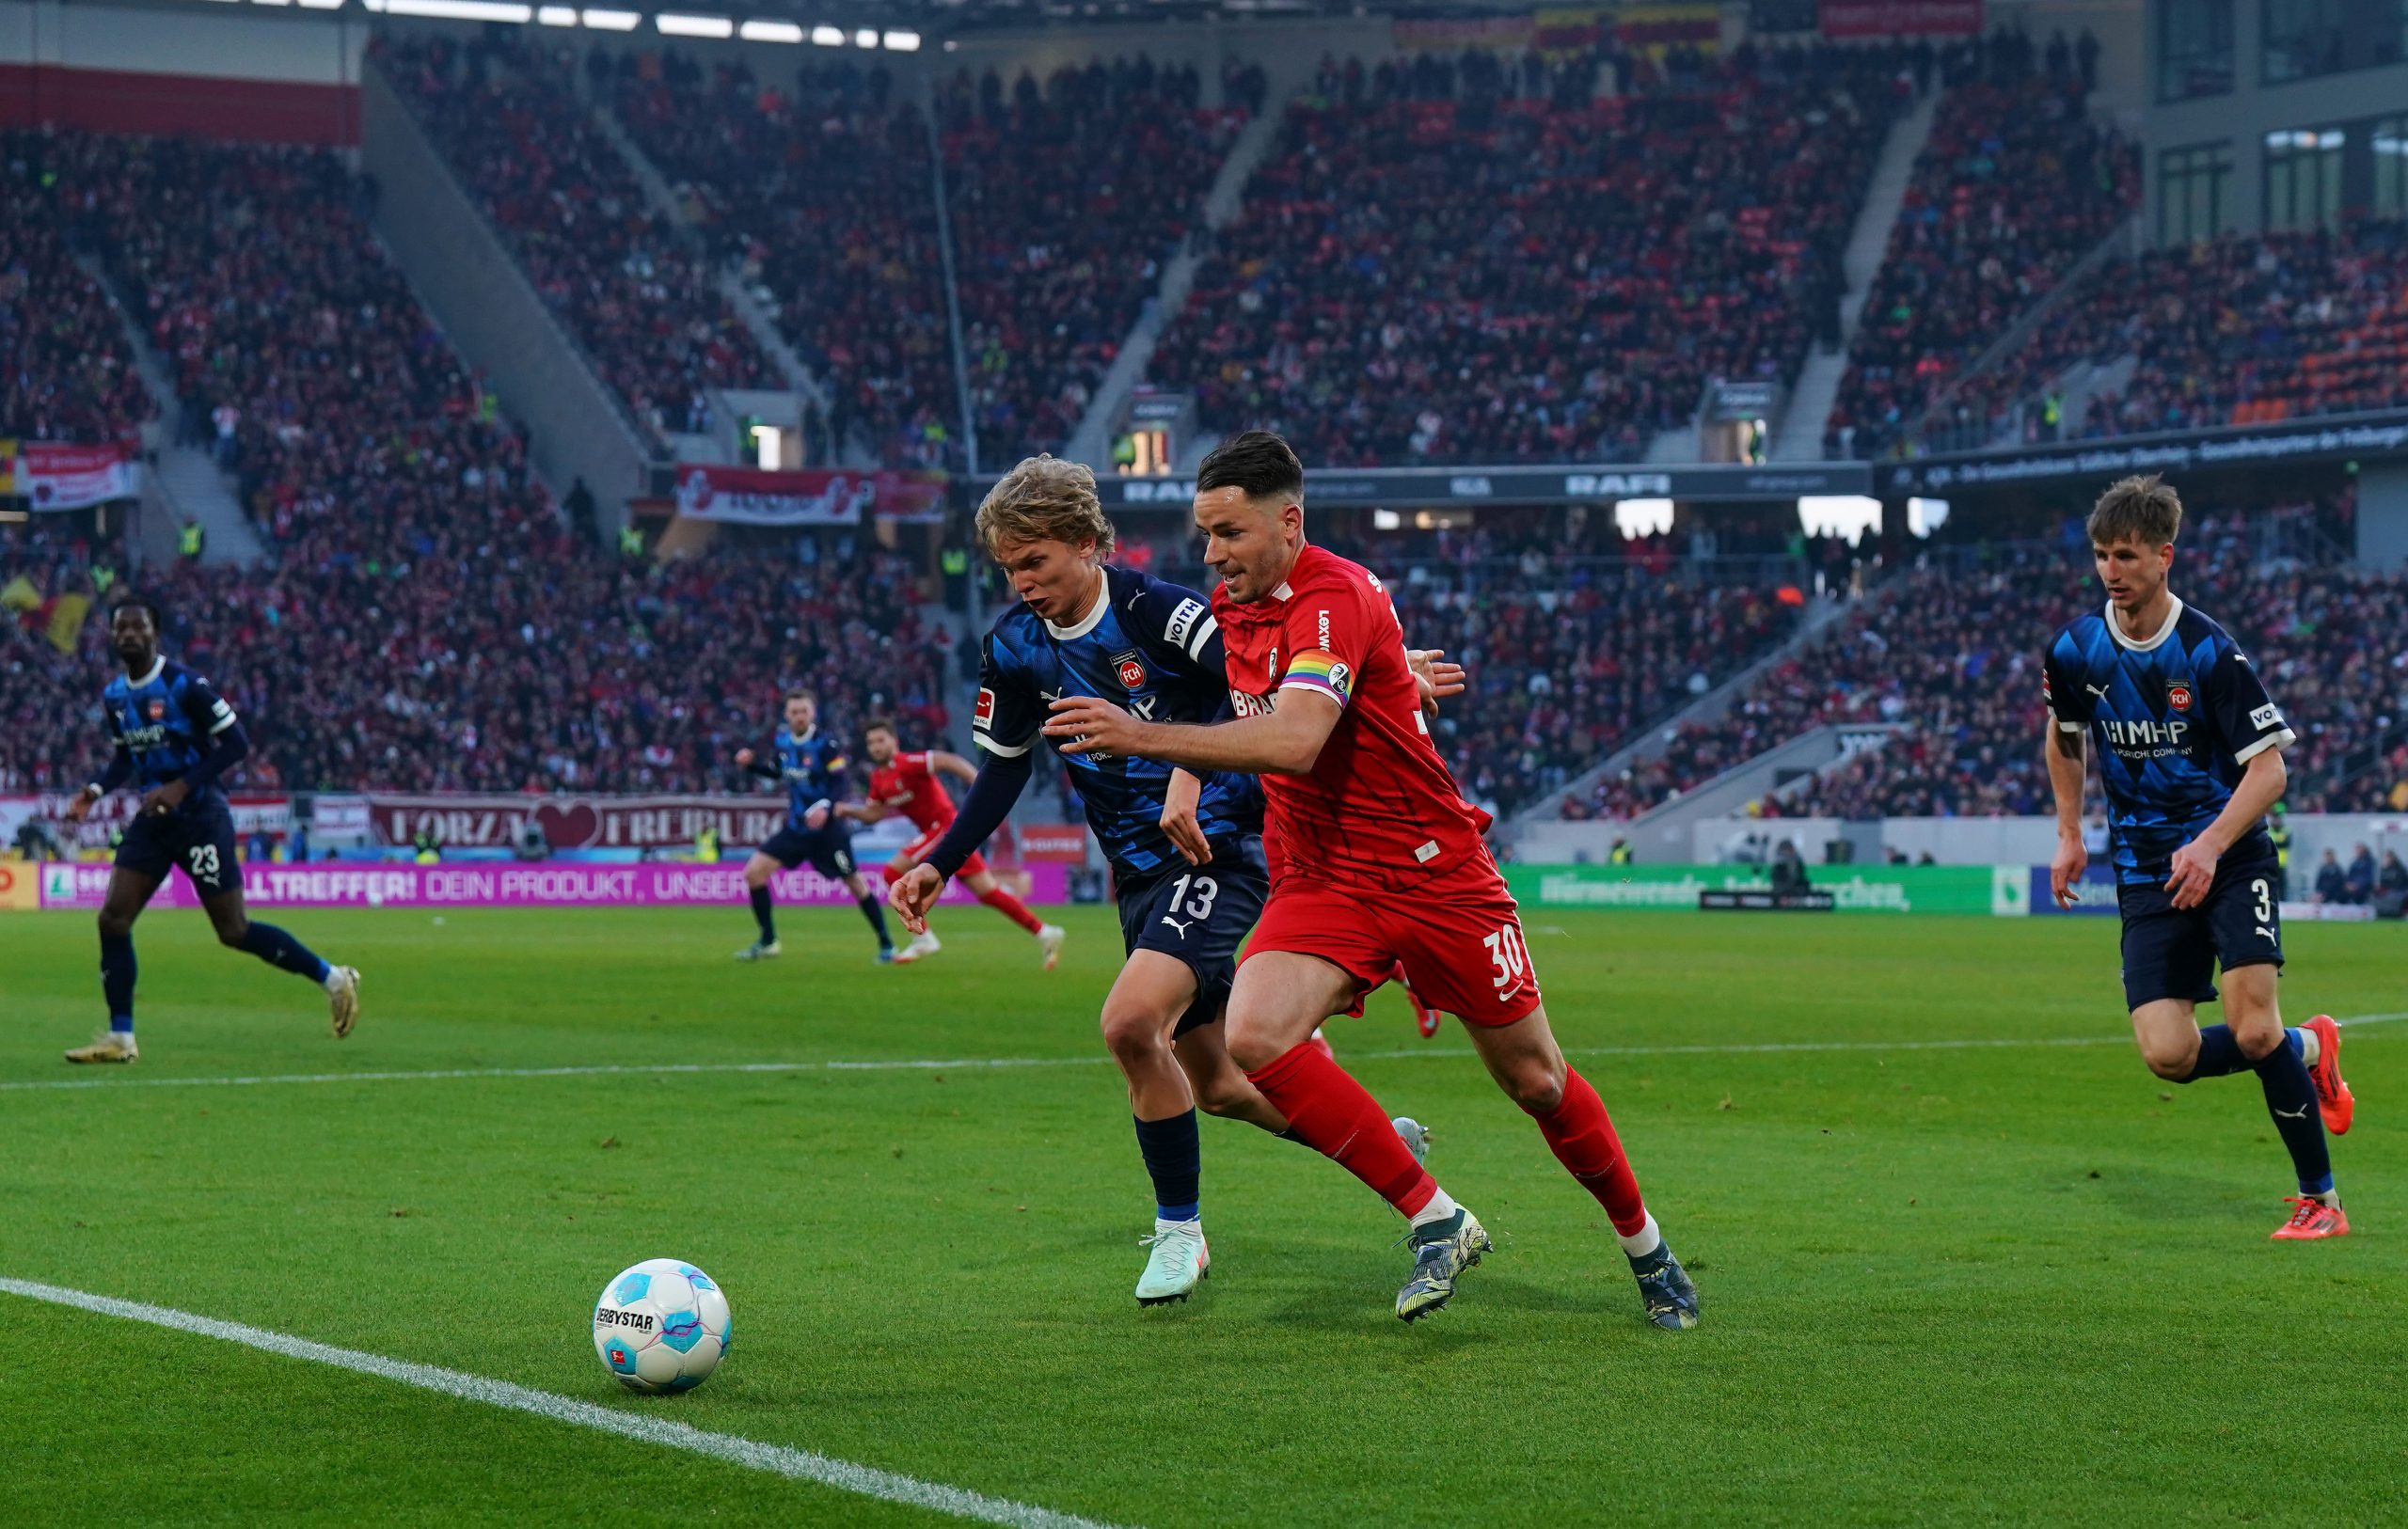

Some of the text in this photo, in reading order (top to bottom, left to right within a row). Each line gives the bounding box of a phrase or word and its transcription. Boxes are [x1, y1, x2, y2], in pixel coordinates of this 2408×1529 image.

[1170, 602, 1199, 641] VOITH
[1123, 667, 1141, 682] FCH
[2172, 694, 2188, 704] FCH
[2128, 720, 2189, 745] MHP
[189, 844, 220, 875] 23
[425, 871, 494, 900] DEIN
[500, 871, 644, 903] PRODUKT,
[1168, 874, 1219, 921] 13
[2252, 878, 2271, 922] 3
[1483, 924, 1524, 988] 30
[596, 1307, 654, 1331] DERBYSTAR
